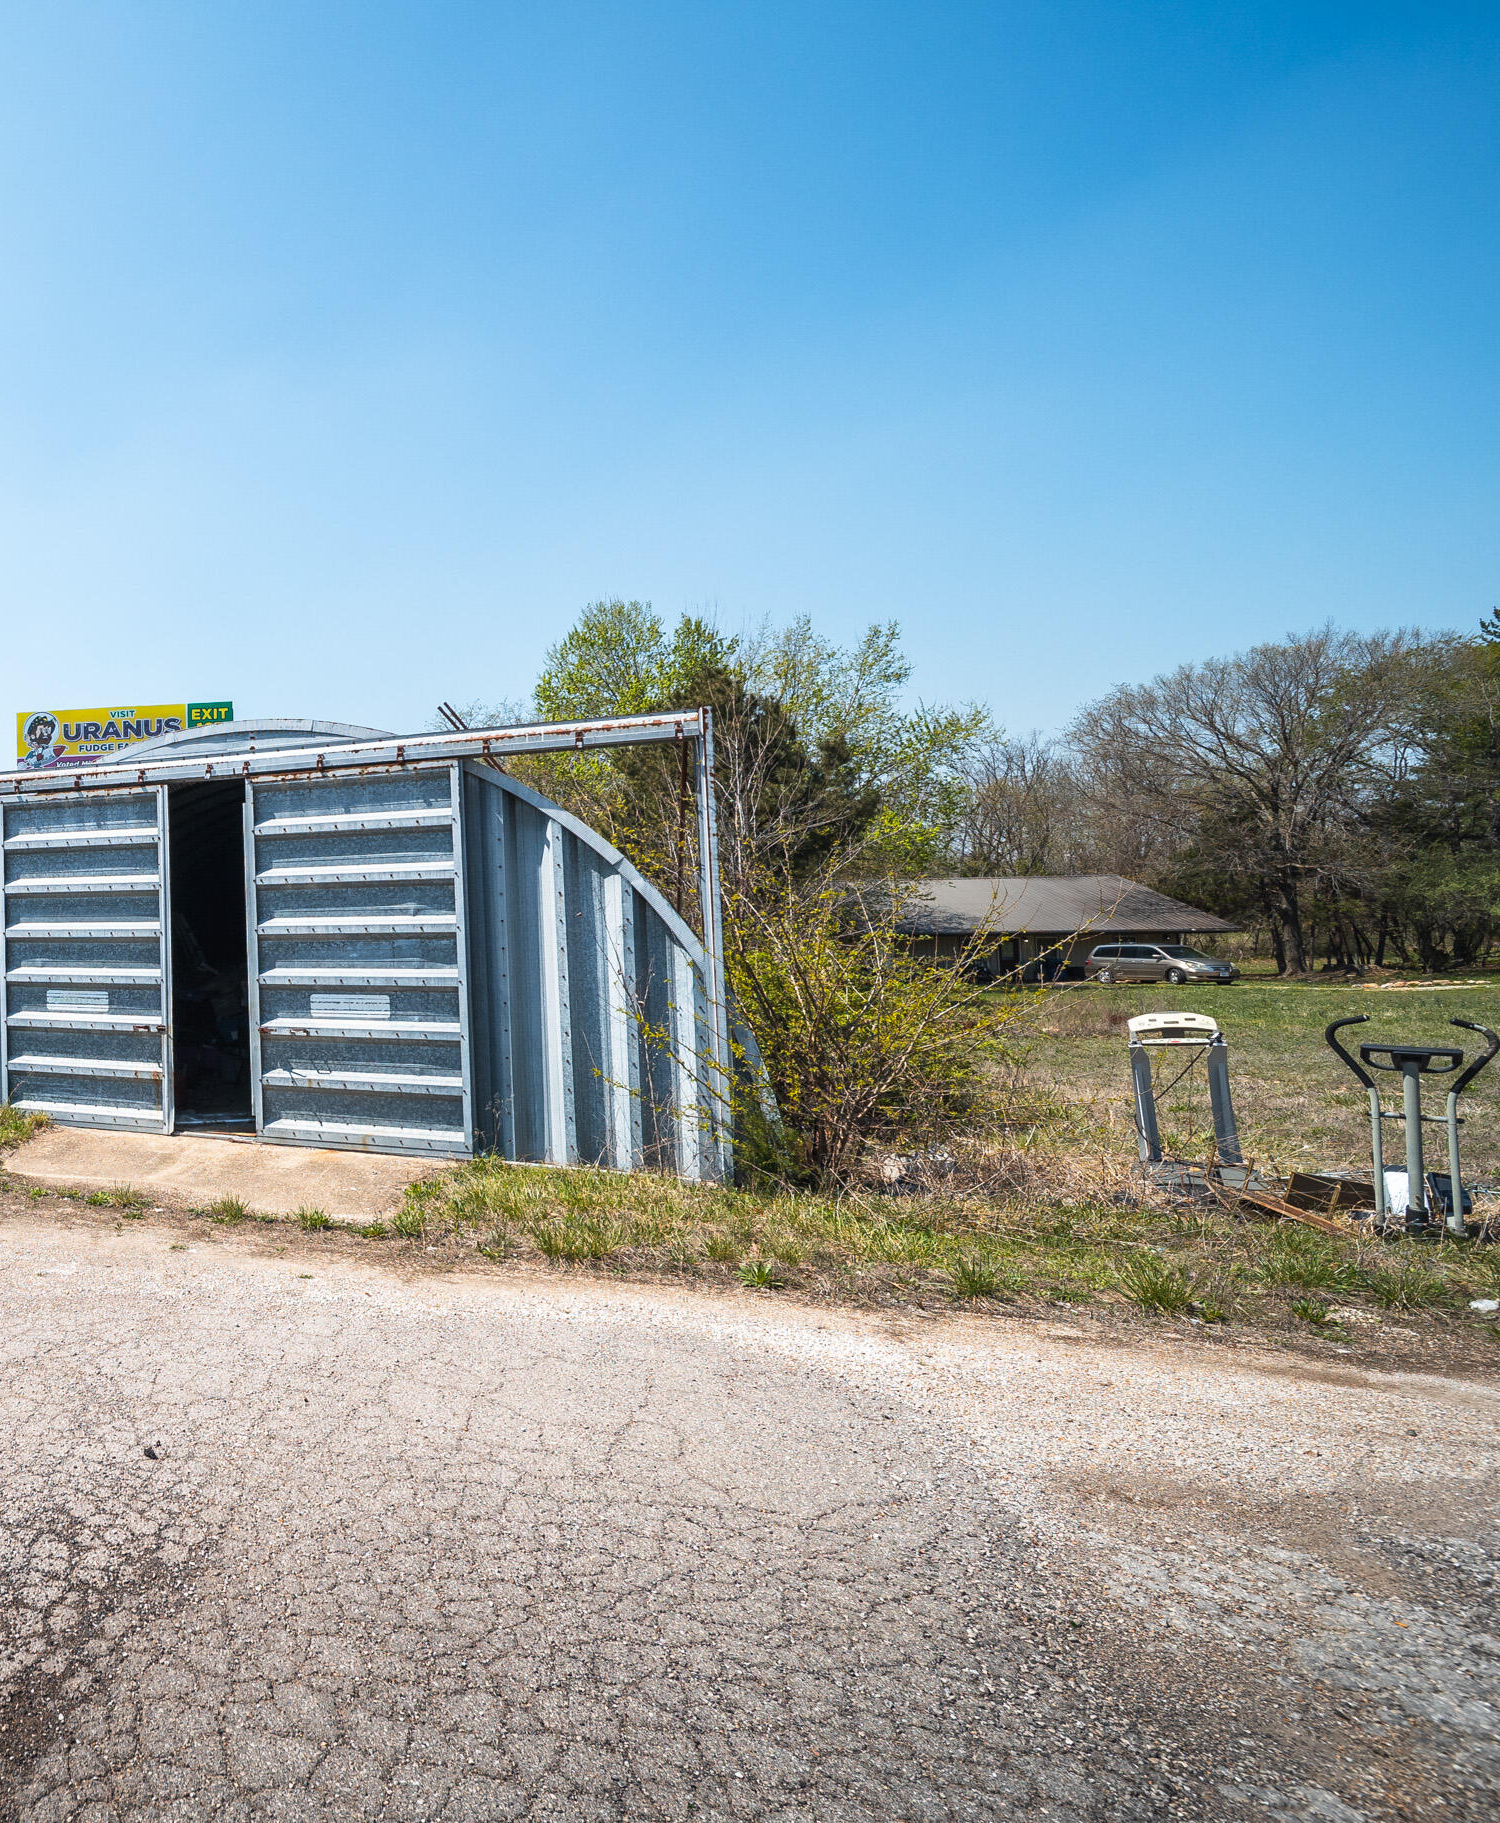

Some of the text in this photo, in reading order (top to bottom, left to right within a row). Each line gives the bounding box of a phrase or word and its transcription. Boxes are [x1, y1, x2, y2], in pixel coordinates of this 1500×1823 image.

[110, 710, 135, 718] VISIT
[191, 707, 229, 720] EXIT
[62, 717, 182, 742] URANUS
[78, 743, 114, 752] FUDGE
